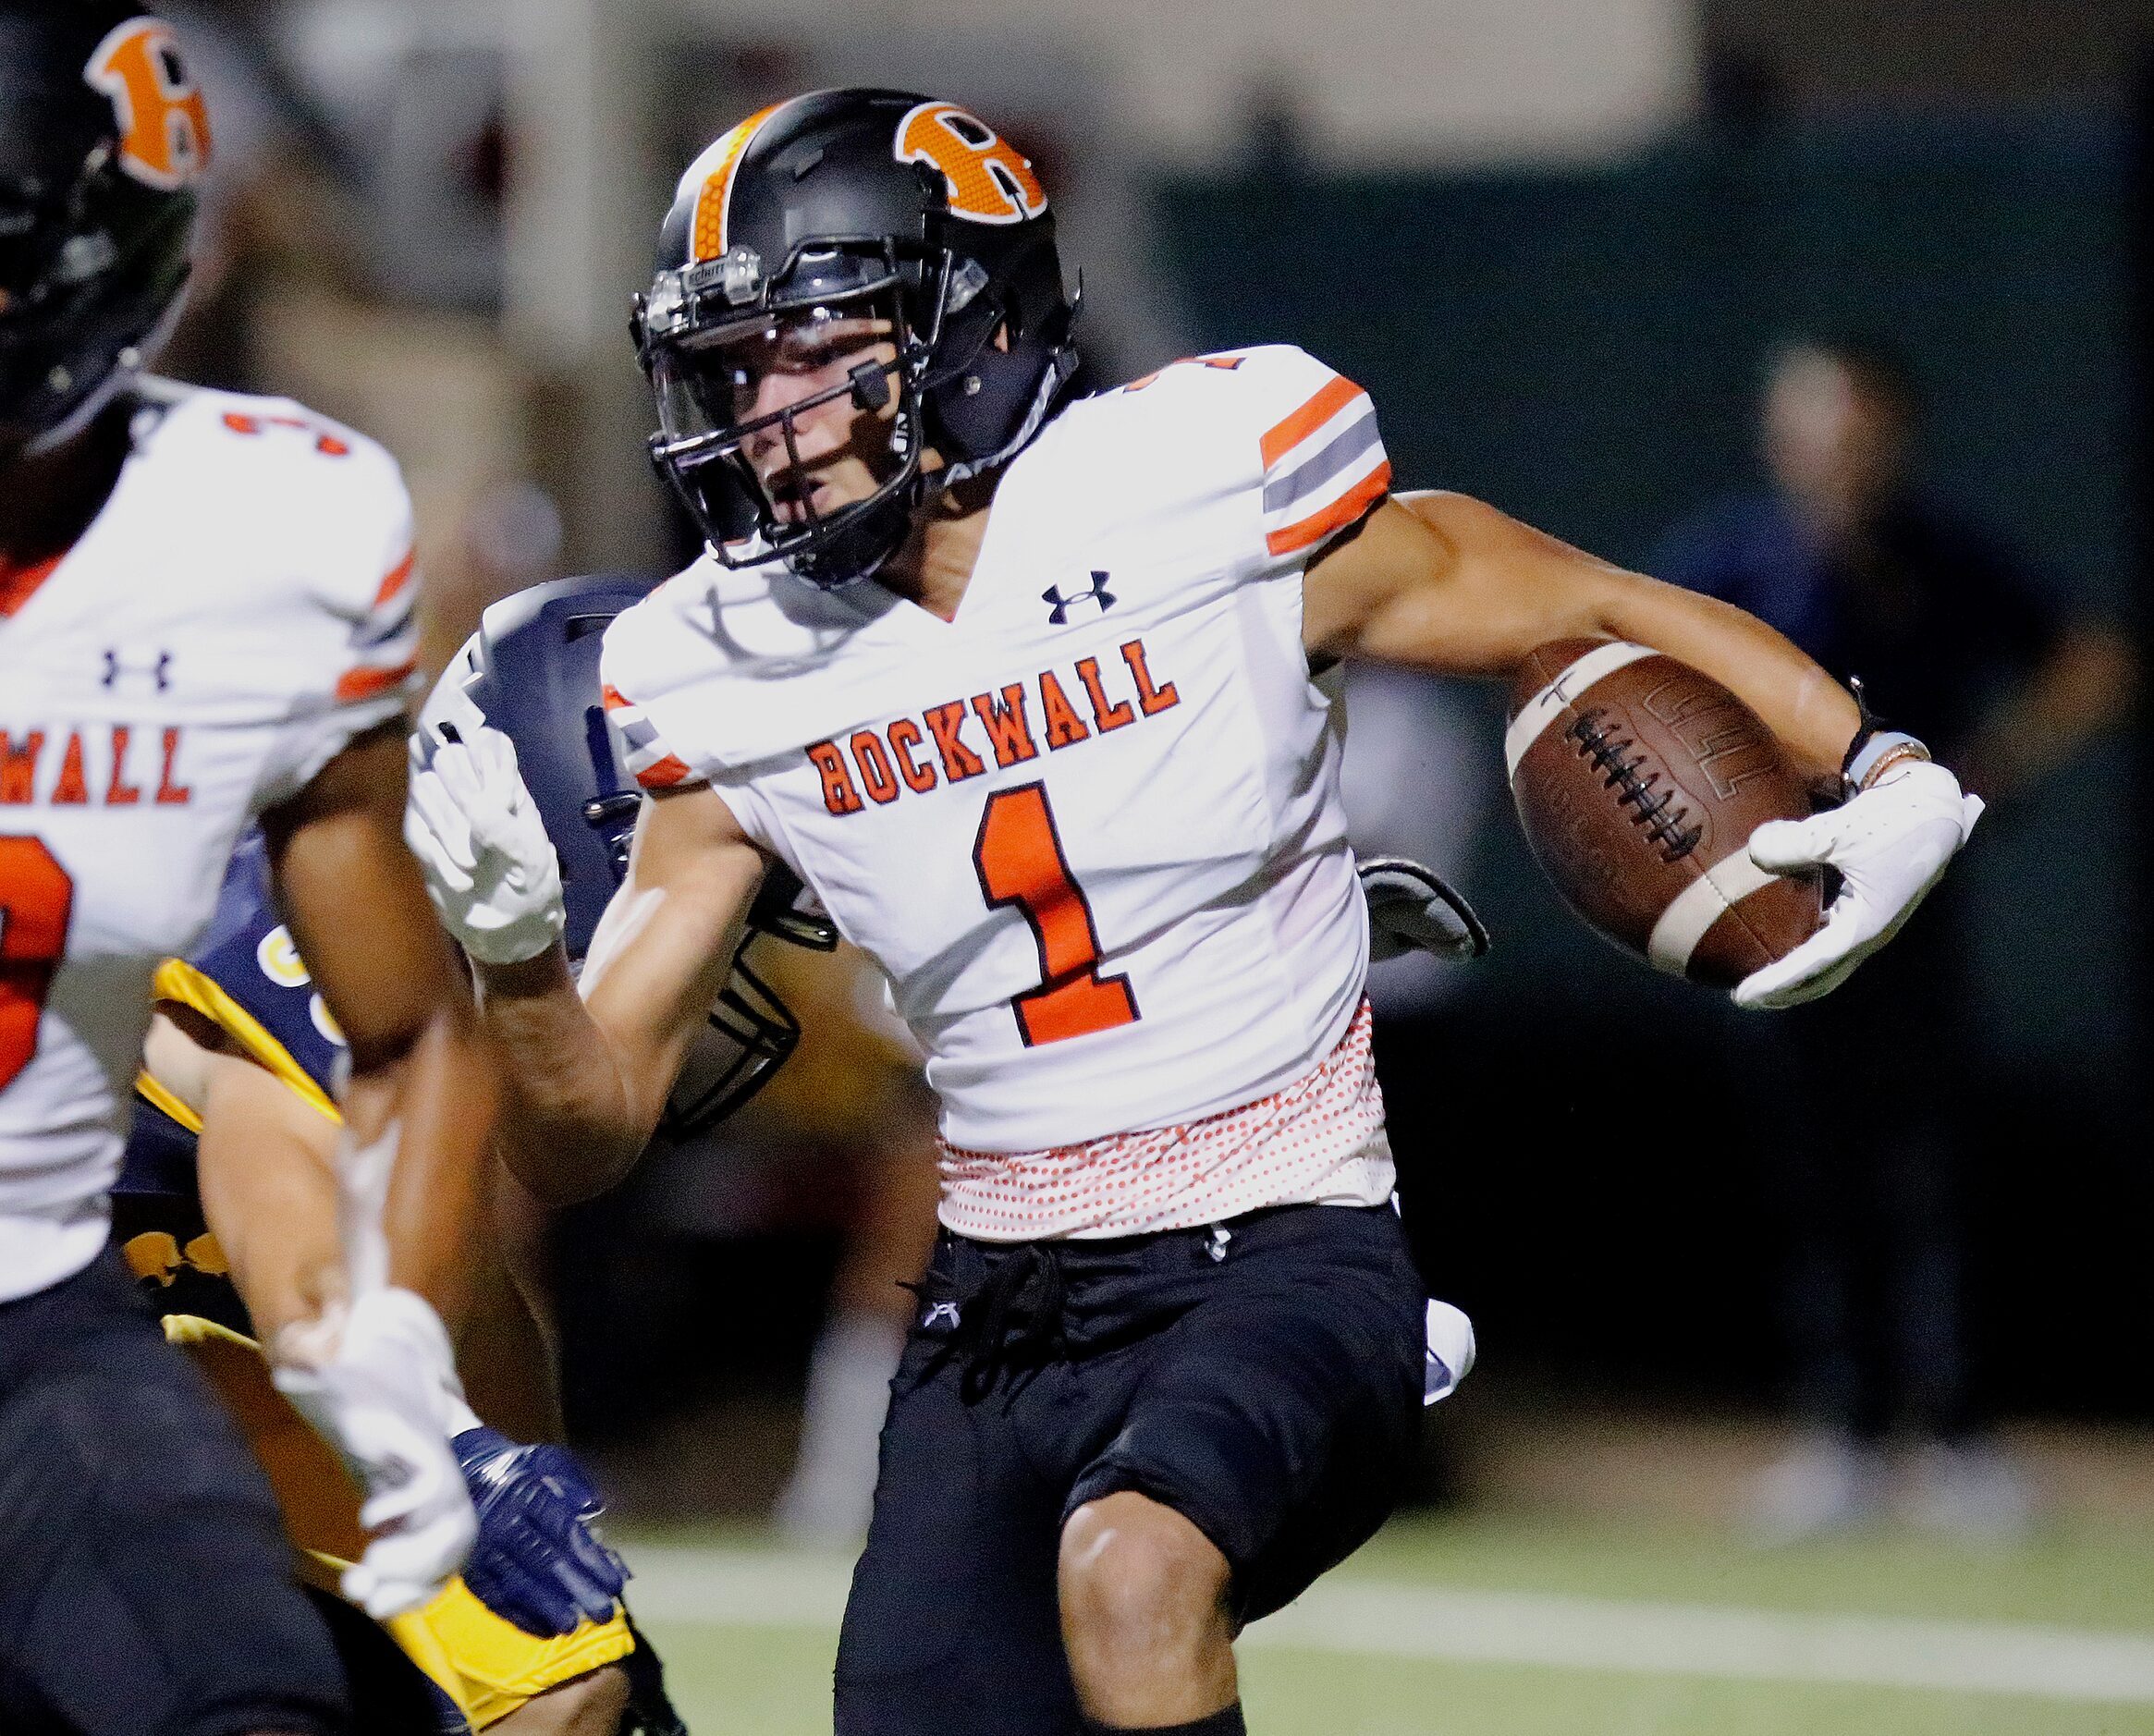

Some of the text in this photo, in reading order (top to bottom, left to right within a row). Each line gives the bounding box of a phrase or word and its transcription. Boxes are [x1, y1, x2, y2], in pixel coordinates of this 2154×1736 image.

[896, 101, 1048, 225] R
[805, 639, 1181, 817] ROCKWALL
[972, 778, 1143, 1048] 1
